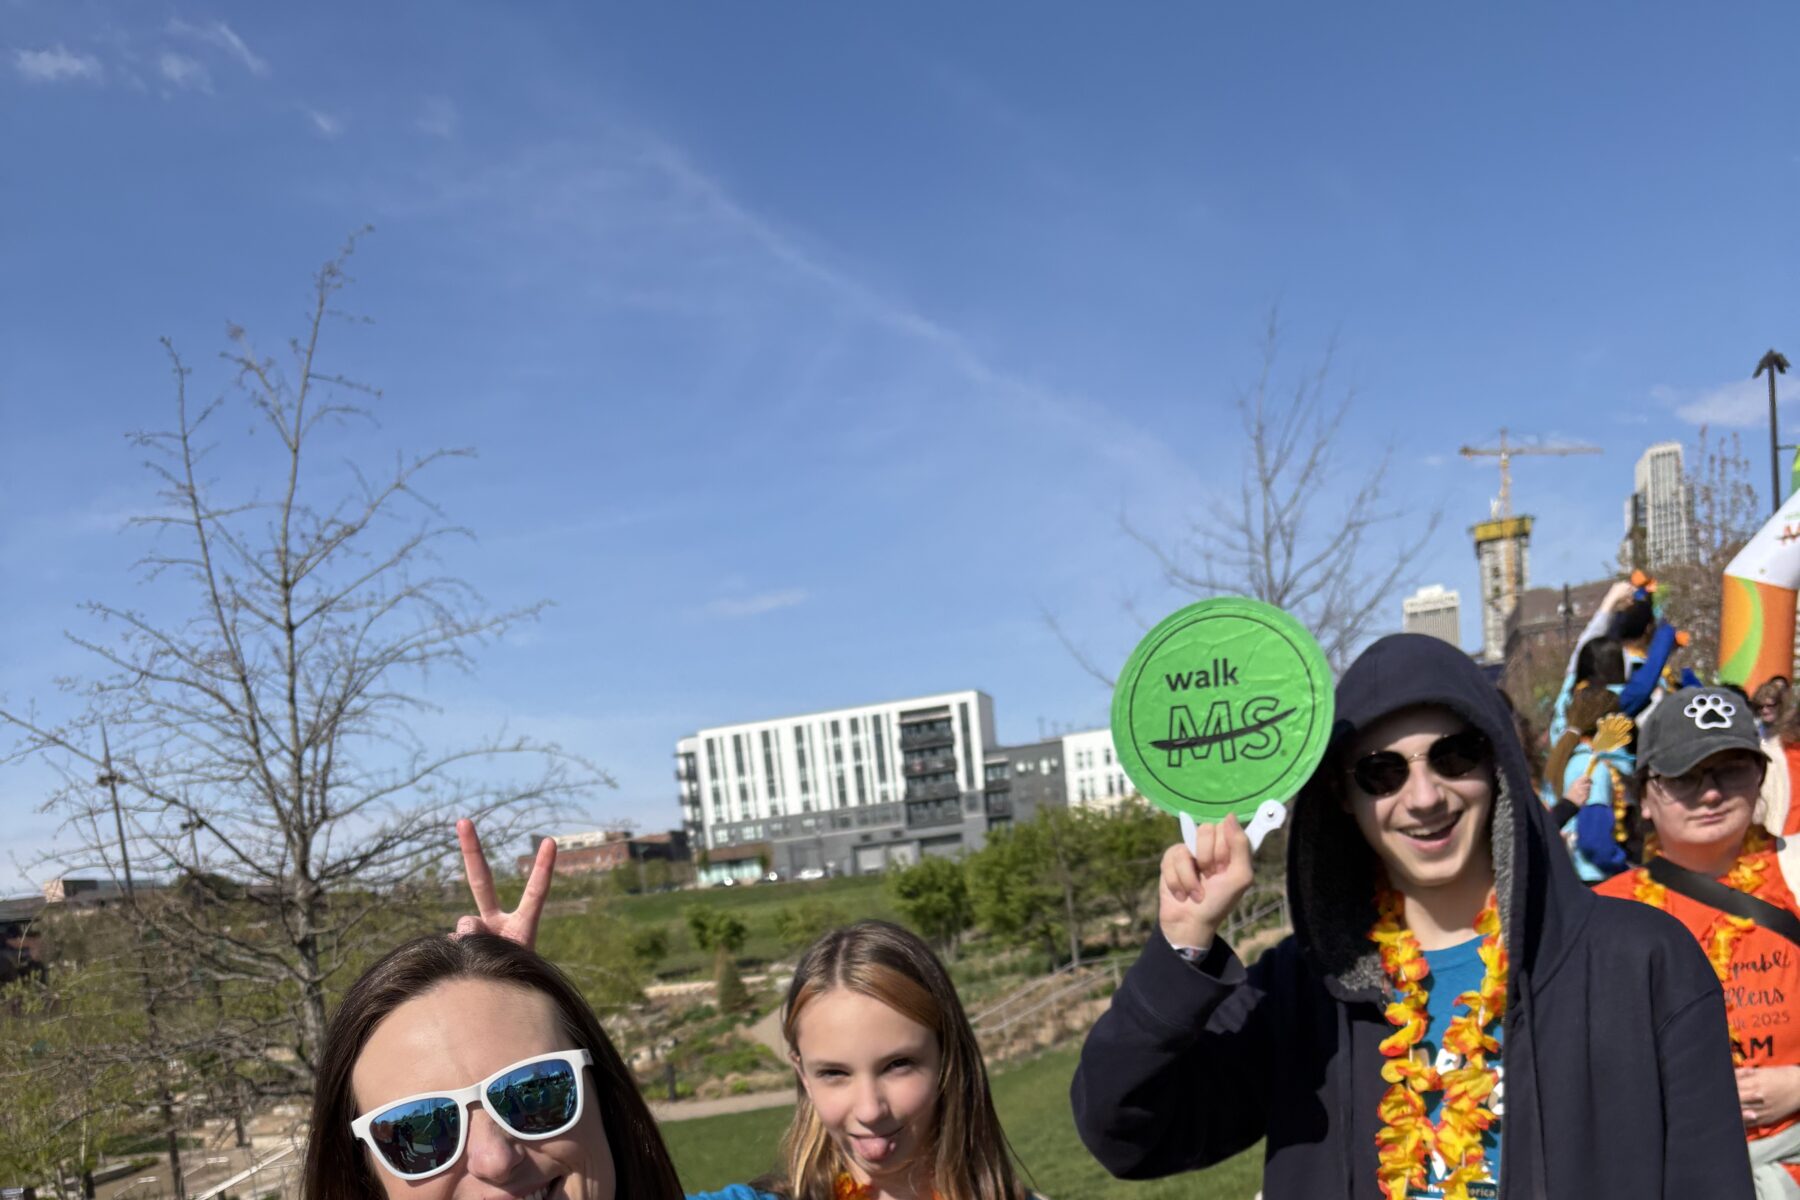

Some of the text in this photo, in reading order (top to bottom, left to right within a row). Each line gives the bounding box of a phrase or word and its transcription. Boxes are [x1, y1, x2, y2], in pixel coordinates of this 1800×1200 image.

[1166, 658, 1238, 691] walk
[1167, 696, 1281, 768] MS
[1752, 1011, 1790, 1028] 2025
